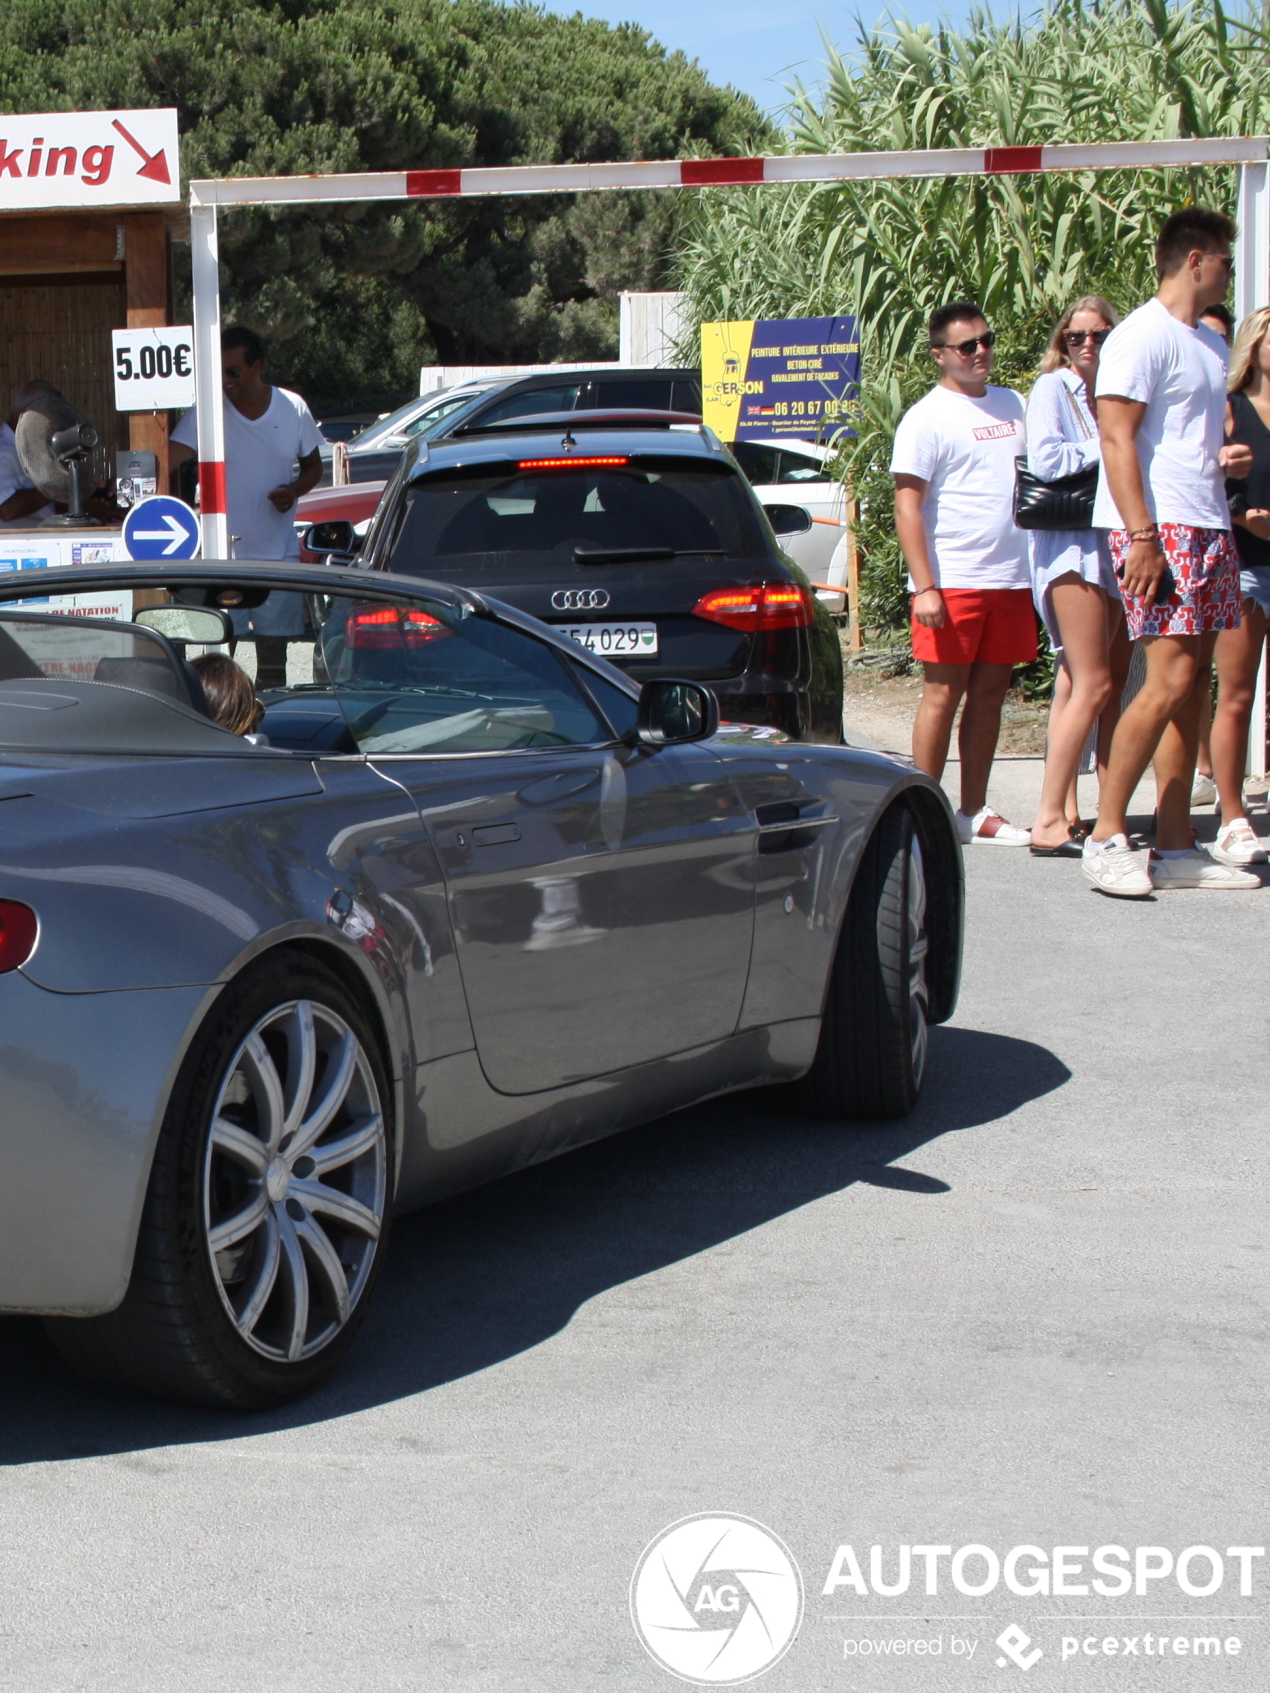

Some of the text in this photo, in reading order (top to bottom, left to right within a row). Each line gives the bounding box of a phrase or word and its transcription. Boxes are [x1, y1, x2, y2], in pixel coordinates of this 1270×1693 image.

[751, 342, 859, 358] PEINTURE INTÉRIEURE EXTÉRIEURE
[116, 343, 192, 381] 5.00€
[786, 360, 807, 370] BETON
[771, 373, 806, 383] RAVALEMENT
[713, 380, 764, 396] GERSON
[774, 402, 788, 416] 06
[791, 401, 805, 415] 20
[808, 401, 821, 415] 67
[824, 400, 838, 413] 00
[973, 423, 1016, 440] VOLTAIRE
[67, 607, 119, 616] NATATION
